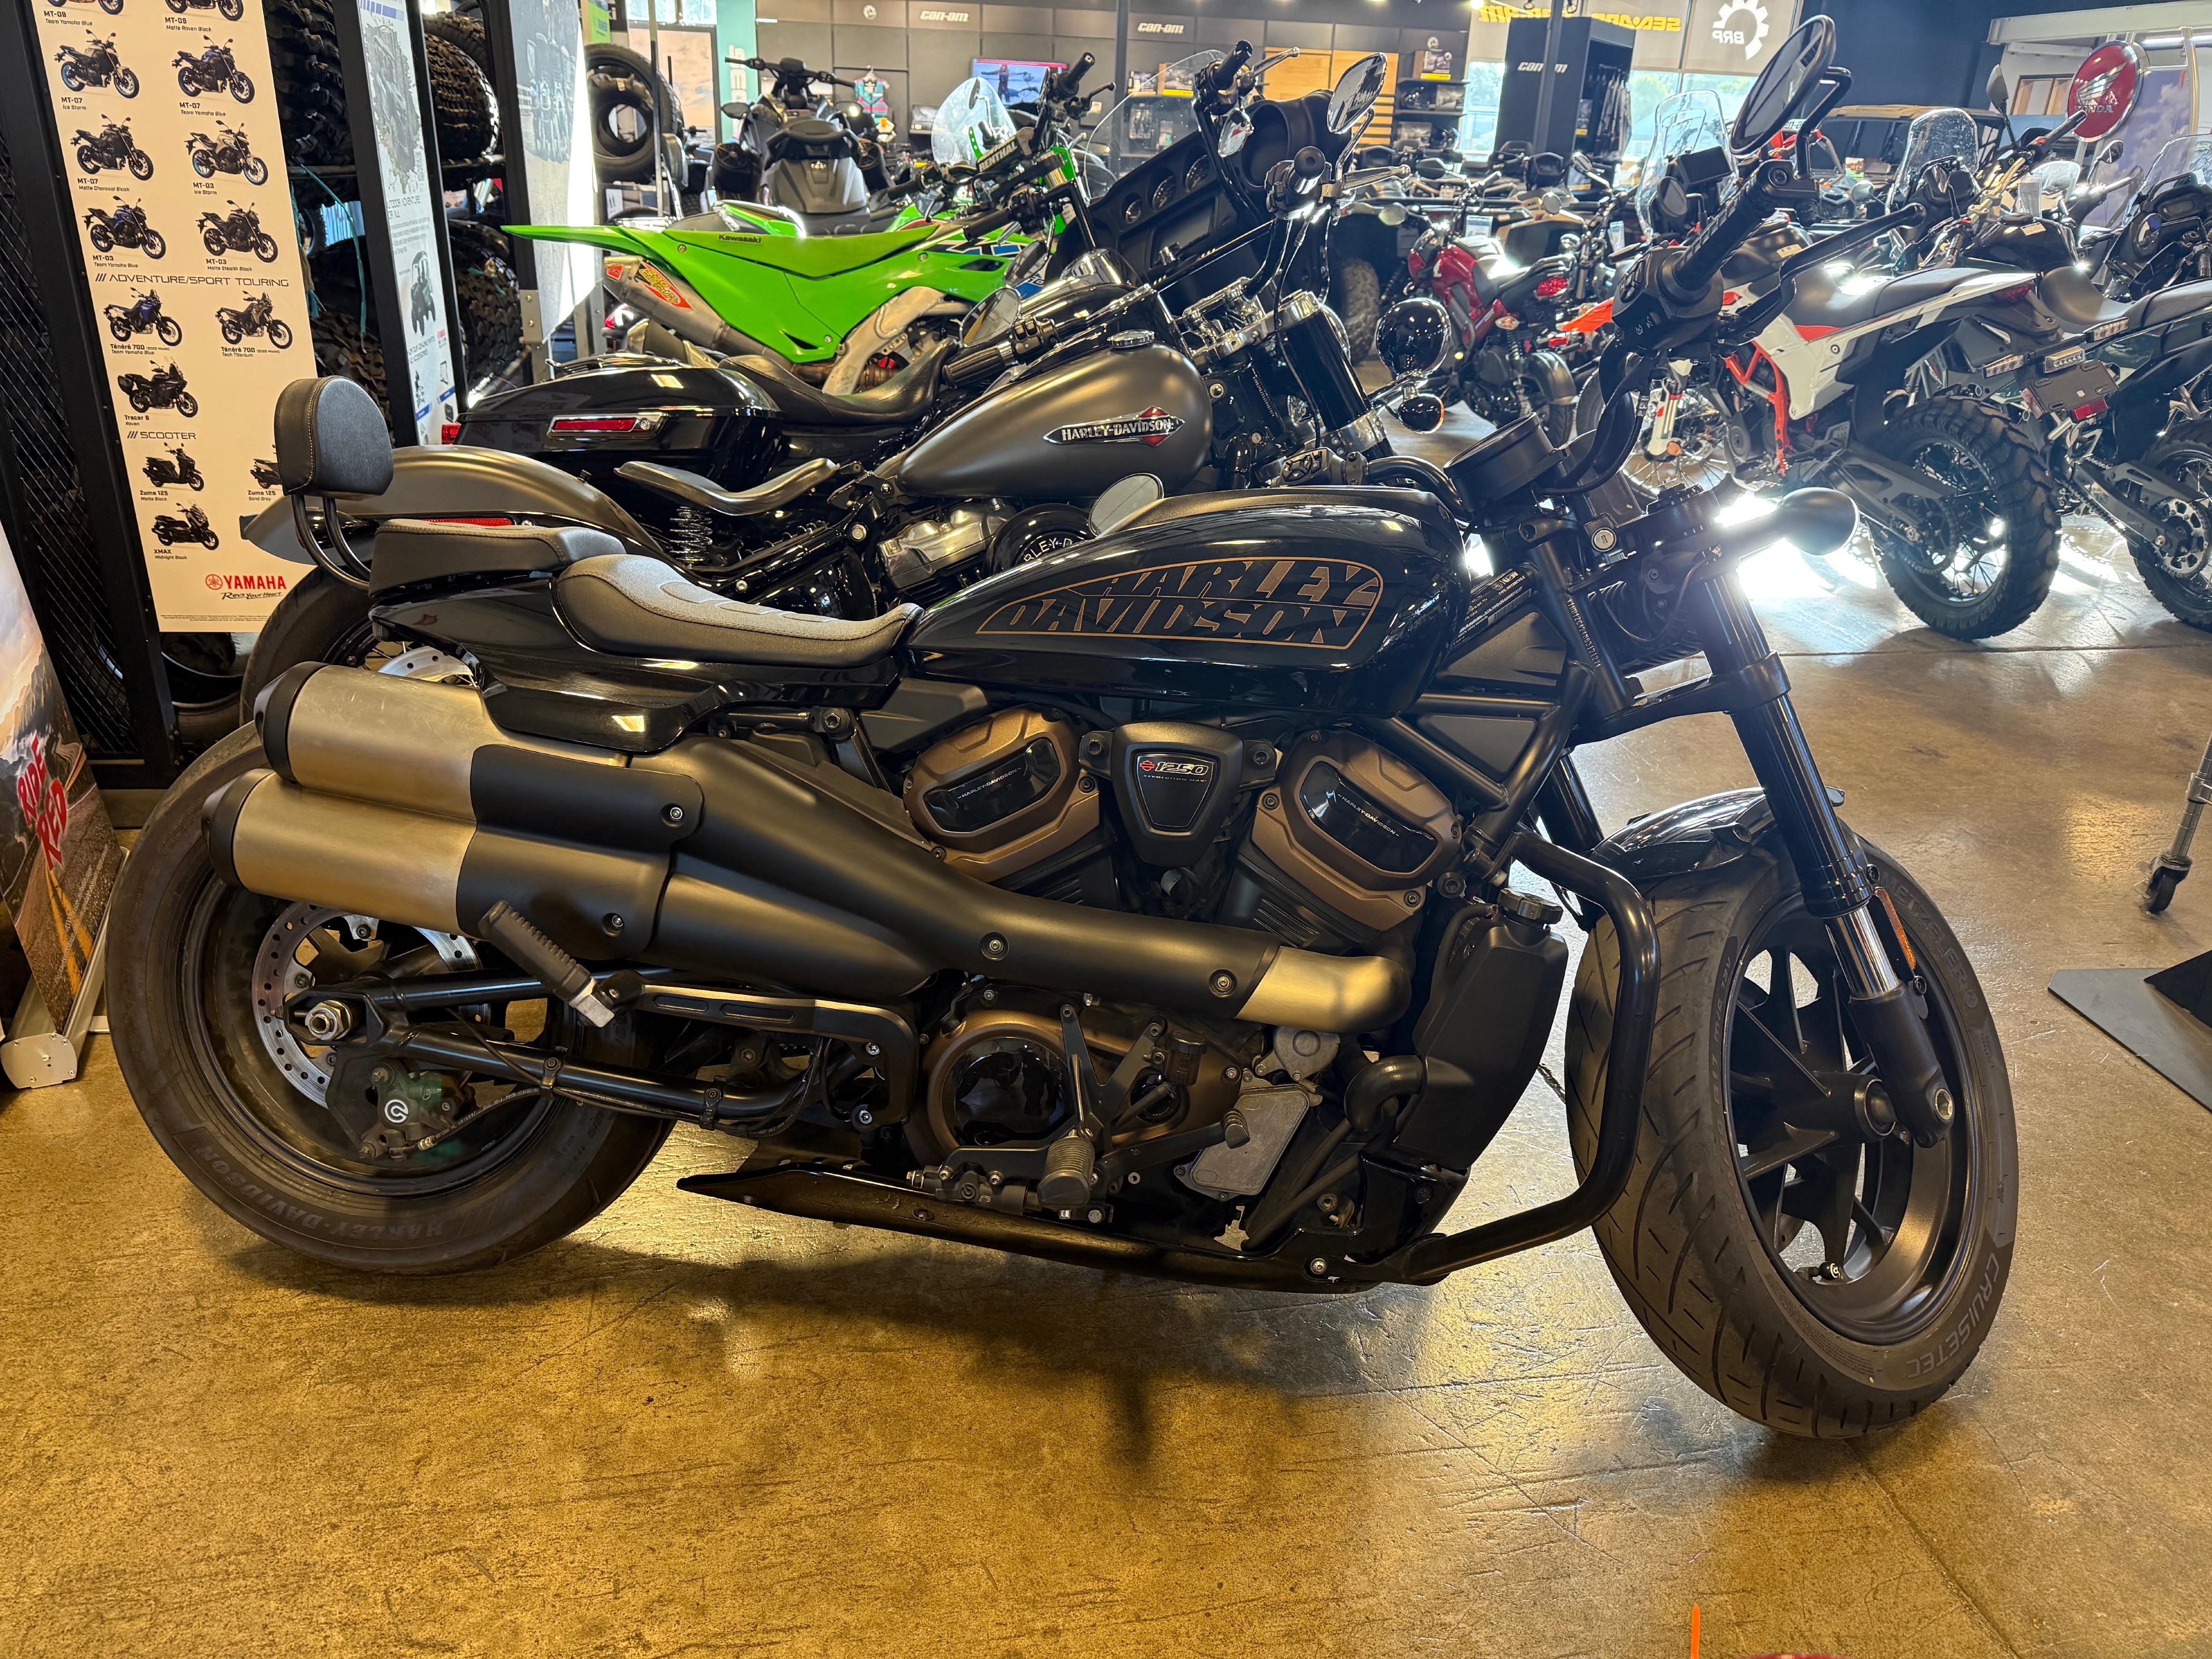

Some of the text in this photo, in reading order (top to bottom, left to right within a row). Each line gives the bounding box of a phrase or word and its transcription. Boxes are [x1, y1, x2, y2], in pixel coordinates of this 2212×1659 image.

[920, 10, 969, 22] can-am
[1138, 22, 1184, 34] can-am
[1517, 61, 1568, 73] canm
[979, 140, 1018, 172] RENTHAL
[719, 234, 762, 243] Kawasaki
[109, 274, 289, 287] ADVENTURE/SPORT TOURING
[1061, 419, 1172, 441] HARLEY-DAVIDSON
[223, 575, 287, 589] YAMAHA
[1097, 560, 1378, 606] HARLEY
[1002, 597, 1349, 644] DAVIDSON
[17, 733, 47, 827] RIDE
[961, 768, 1017, 798] HARLEY-DAVIDSON
[1154, 761, 1209, 776] 1250
[36, 779, 67, 871] RED
[1342, 796, 1396, 835] HARLEY-DAVIDSON
[1881, 872, 1968, 986] METZELER
[1906, 1252, 2000, 1379] CRUISETEC
